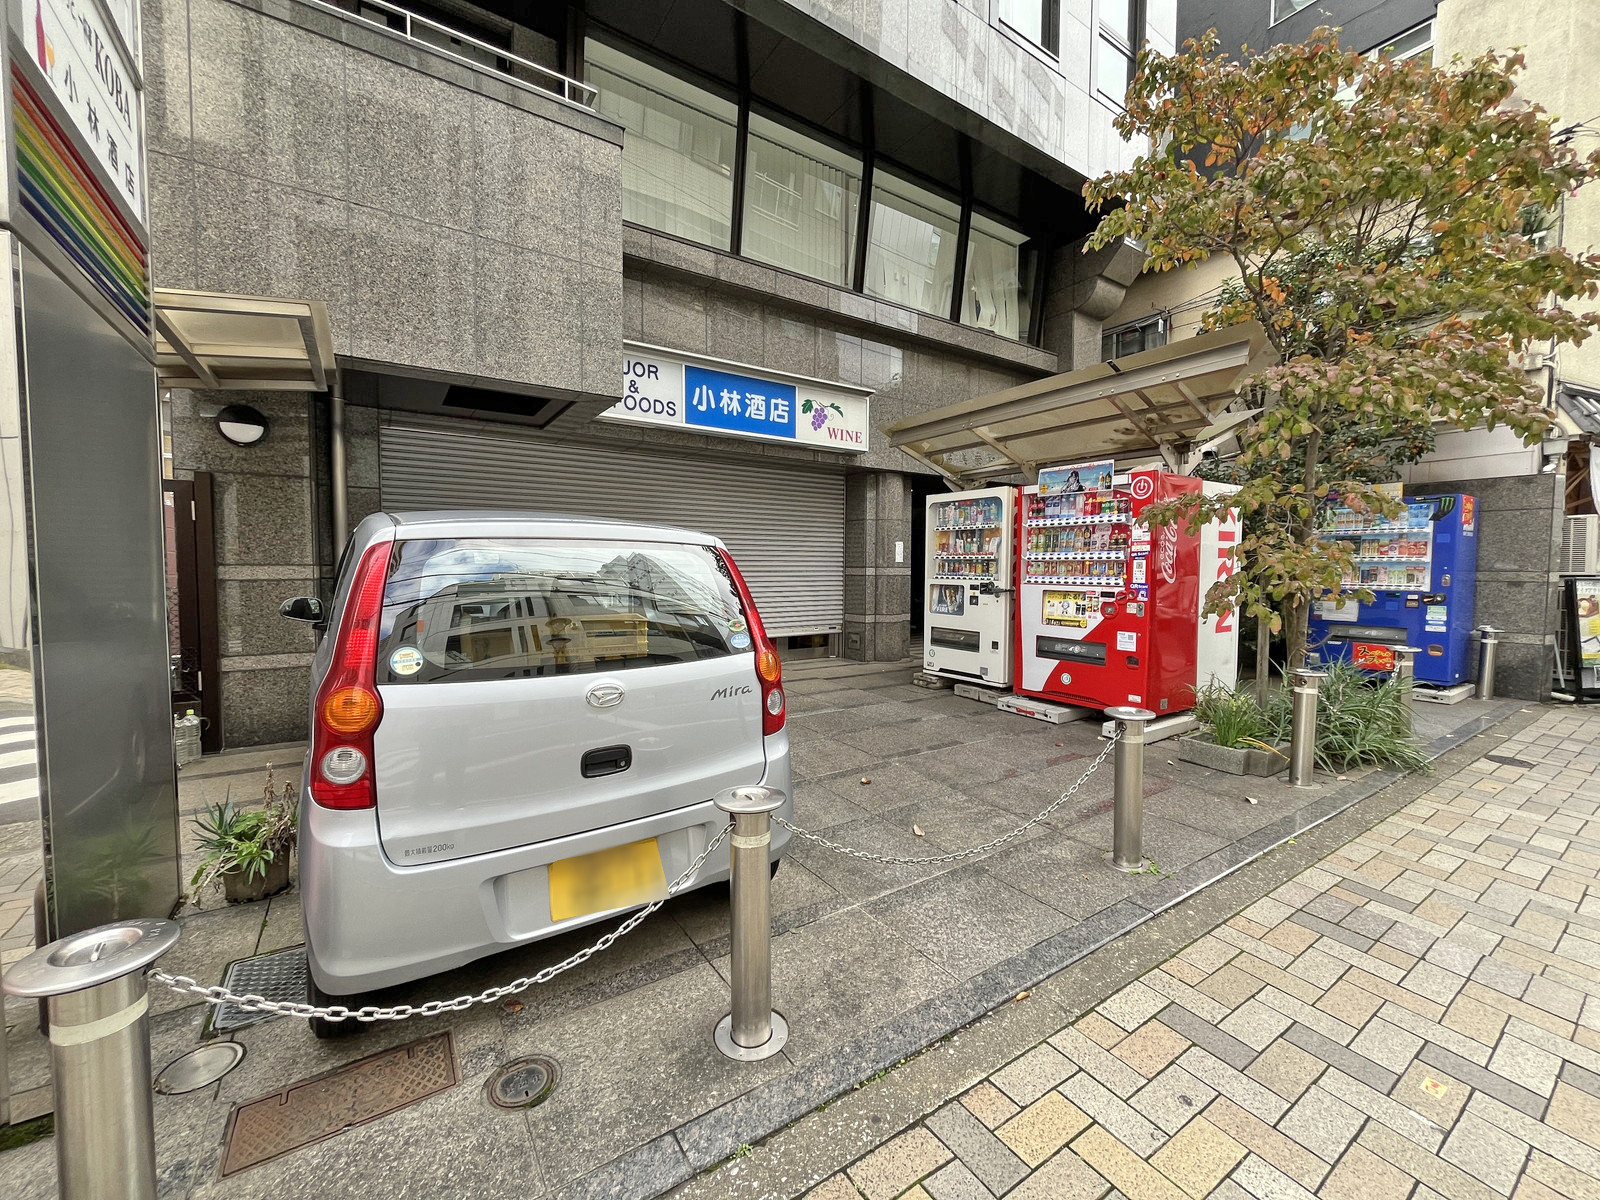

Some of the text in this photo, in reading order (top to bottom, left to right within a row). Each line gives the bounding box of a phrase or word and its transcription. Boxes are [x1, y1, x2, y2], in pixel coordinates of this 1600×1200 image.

[93, 28, 132, 132] KOBA
[64, 64, 135, 200] 小林酒店
[628, 379, 640, 394] &
[613, 394, 677, 417] OODS
[692, 384, 790, 424] 小林酒店
[827, 426, 863, 444] WINE
[710, 685, 753, 701] Mira
